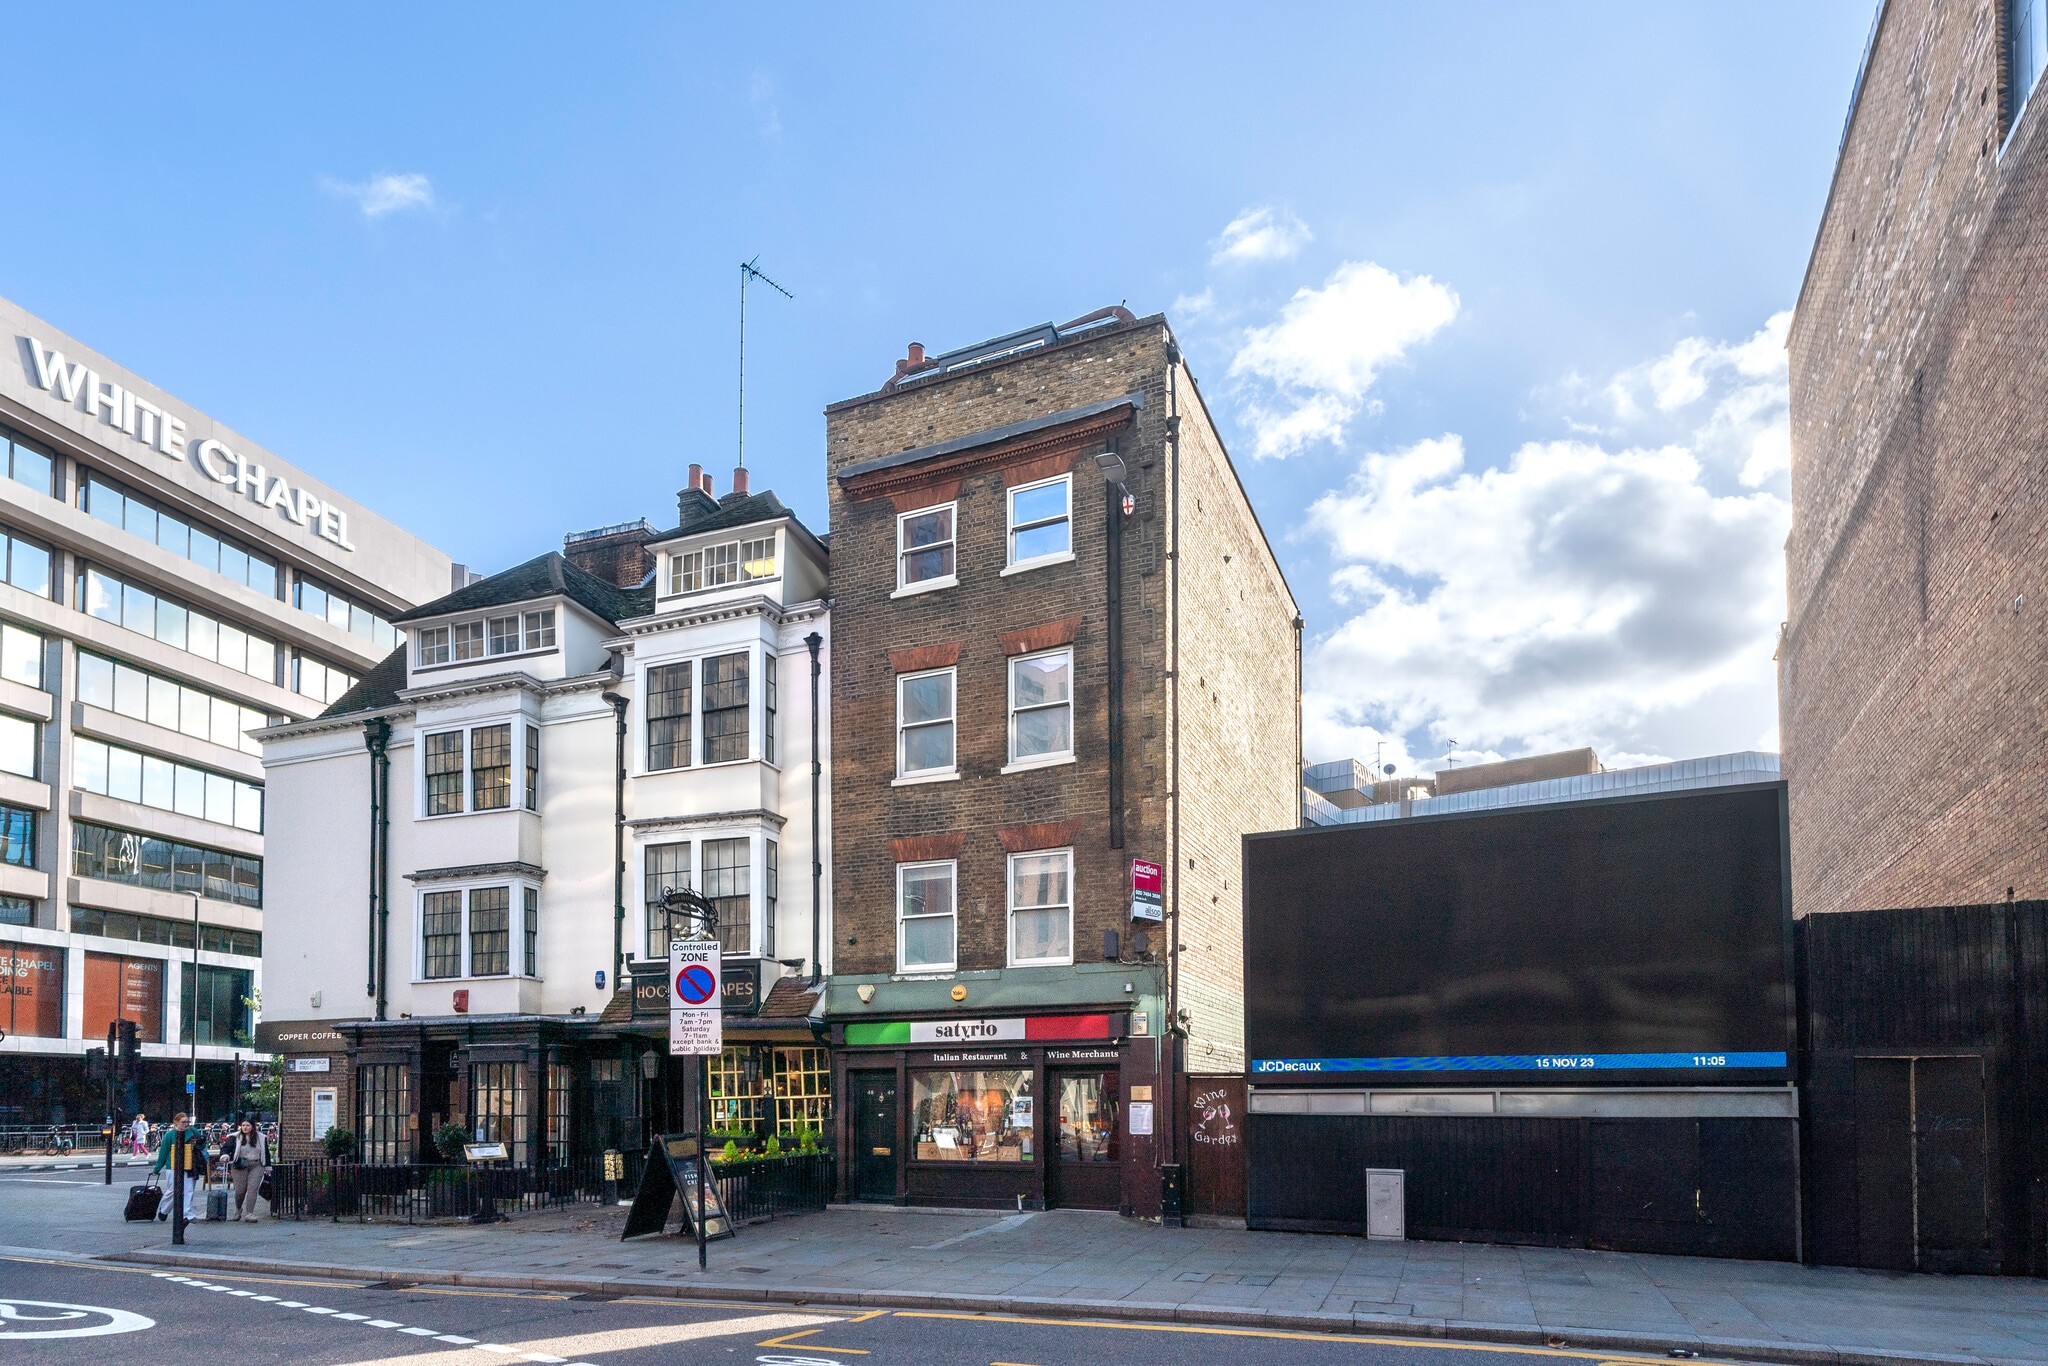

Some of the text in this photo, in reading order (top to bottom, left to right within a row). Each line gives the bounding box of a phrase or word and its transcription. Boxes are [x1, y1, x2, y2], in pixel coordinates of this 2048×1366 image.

[27, 336, 356, 553] WHITE CHAPEL
[1135, 864, 1158, 876] auction
[1145, 905, 1161, 917] allsop
[672, 943, 718, 951] Controlled
[681, 953, 708, 961] ZONE
[9, 957, 55, 971] CHAPEL
[127, 962, 158, 973] AGENTS
[935, 1019, 998, 1041] satyrio
[278, 1032, 342, 1041] COPPER COFFEE
[933, 1052, 1028, 1062] Italian Restaurant &
[1047, 1050, 1119, 1059] Wine Merchants
[1259, 1056, 1726, 1071] JCDecaux 15 NOV 23 11:05
[1194, 1089, 1227, 1109] Wine
